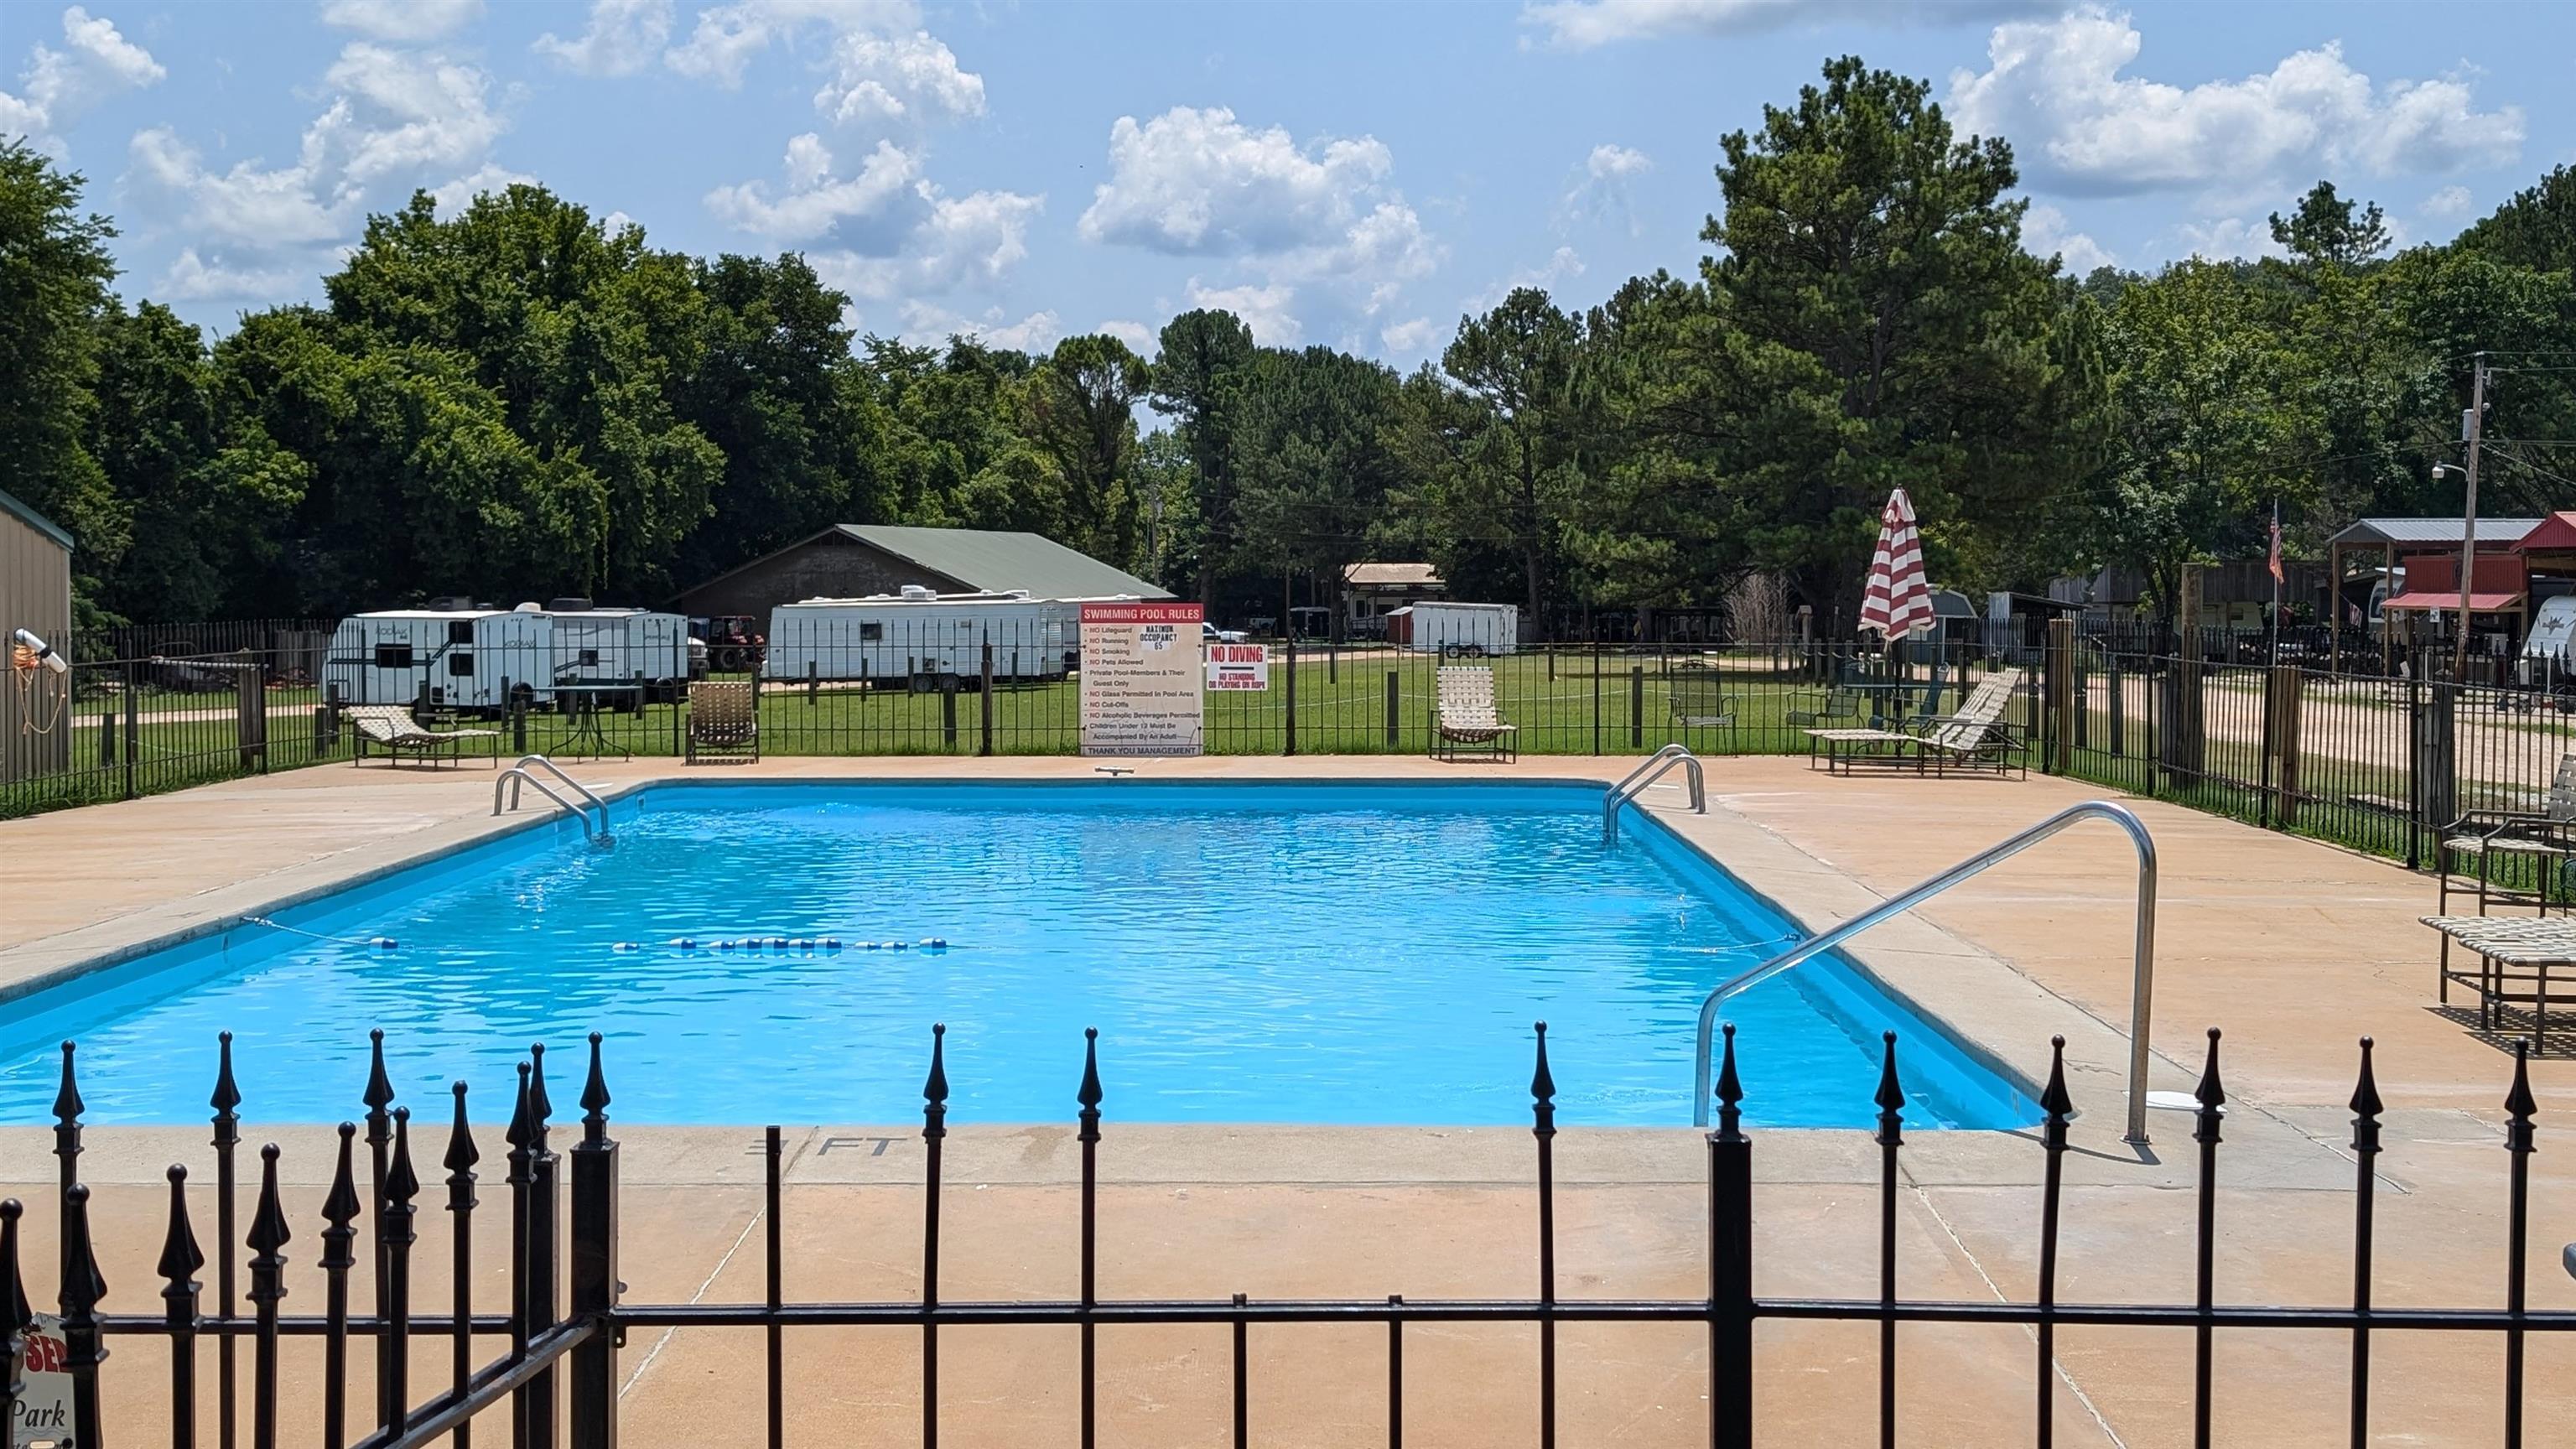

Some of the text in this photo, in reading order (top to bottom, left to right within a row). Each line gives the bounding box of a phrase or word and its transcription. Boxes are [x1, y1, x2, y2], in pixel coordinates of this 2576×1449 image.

[1084, 609, 1200, 620] SWIMMING POOL RULES
[1102, 626, 1132, 635] Lifeguard
[1140, 633, 1177, 641] OCCUPANCY
[1211, 646, 1263, 662] NO DIVING
[1114, 680, 1129, 688] Only
[1134, 712, 1167, 720] Beverages
[817, 1137, 907, 1156] FT
[13, 1400, 65, 1427] Park
